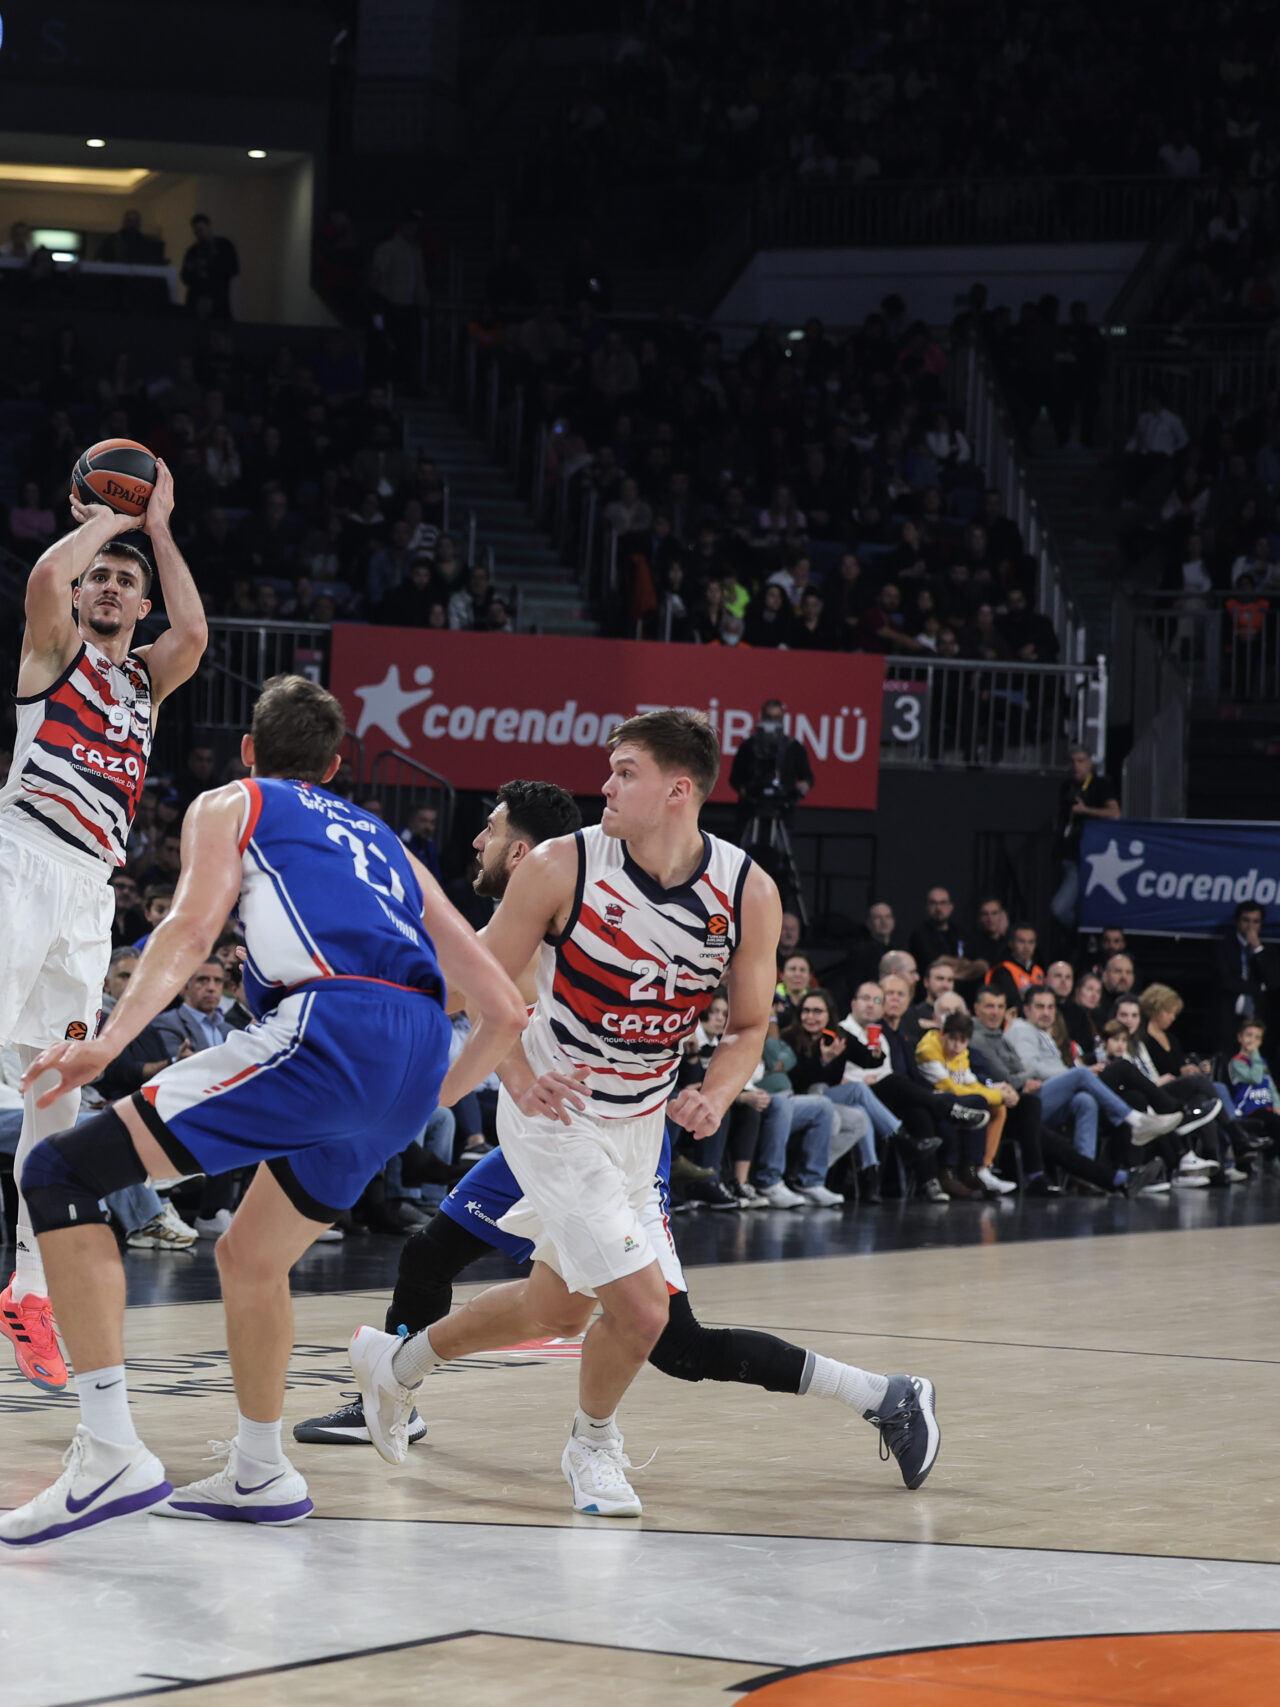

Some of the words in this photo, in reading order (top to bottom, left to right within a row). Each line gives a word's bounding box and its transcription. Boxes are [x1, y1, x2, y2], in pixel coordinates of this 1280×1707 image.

[104, 704, 132, 743] 9
[891, 694, 921, 742] 3
[629, 959, 679, 1001] 21
